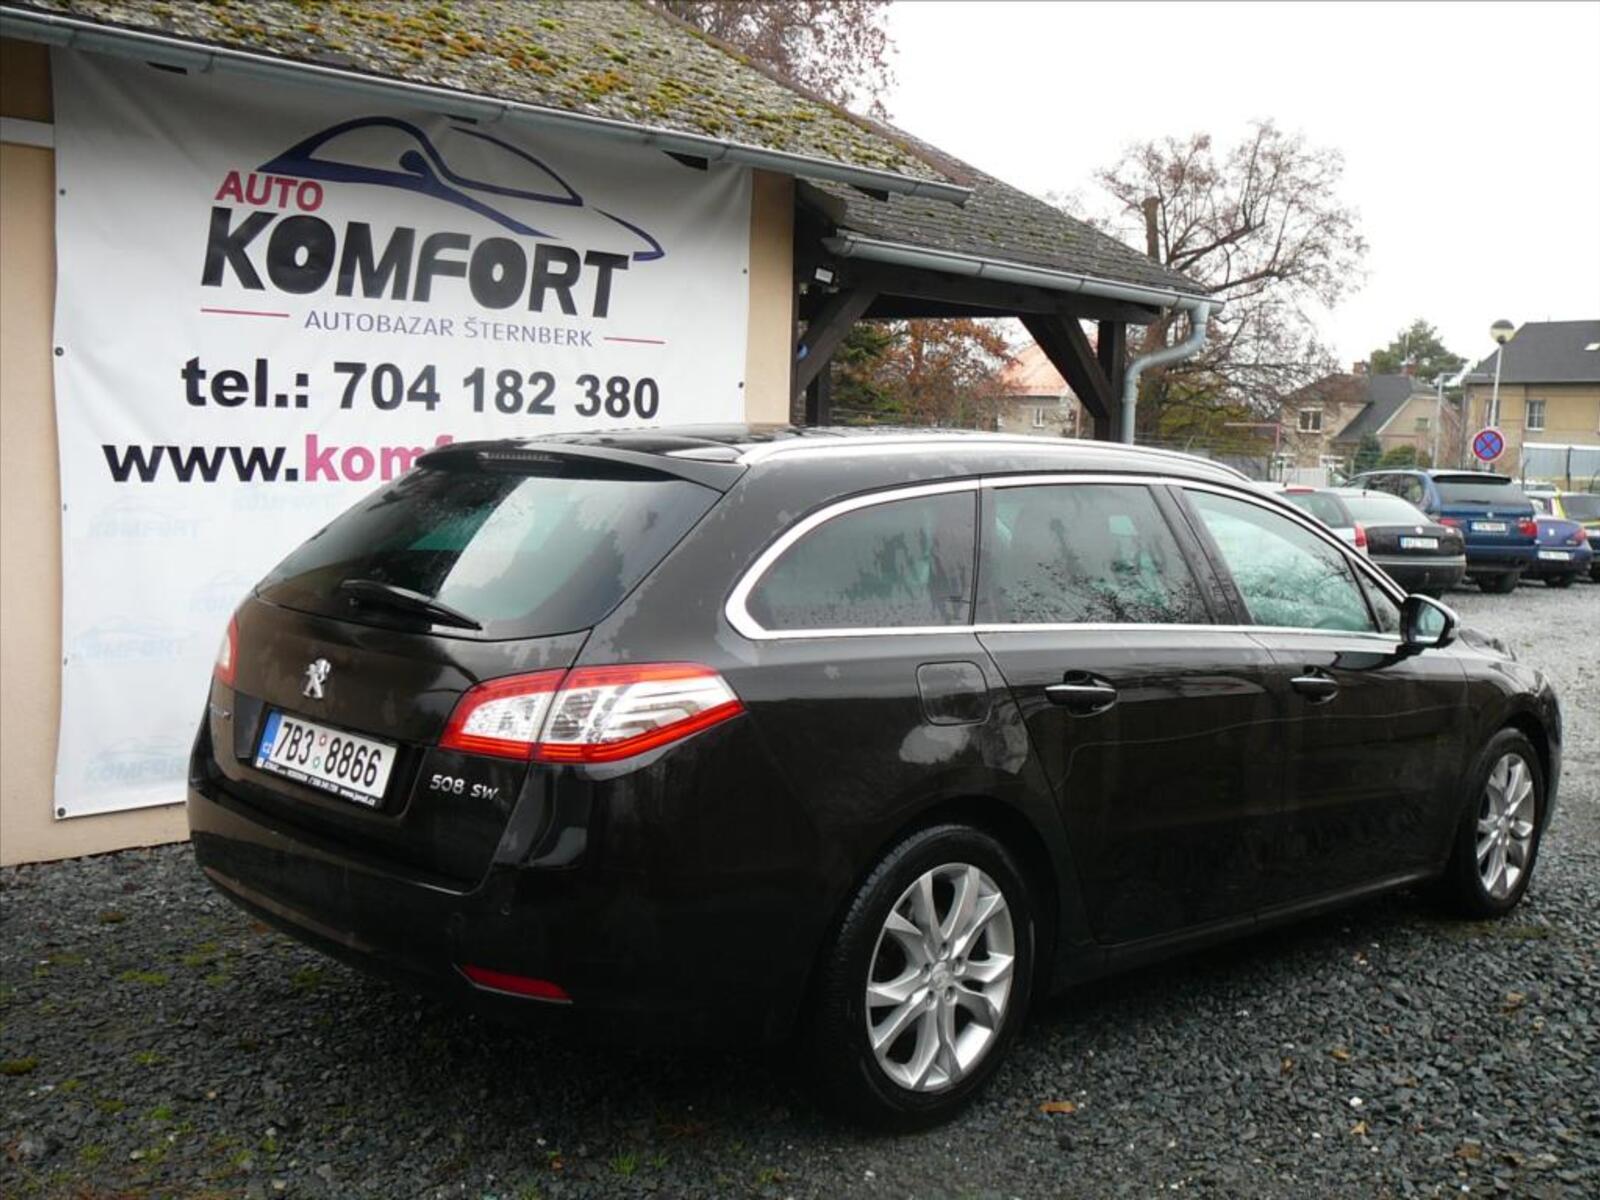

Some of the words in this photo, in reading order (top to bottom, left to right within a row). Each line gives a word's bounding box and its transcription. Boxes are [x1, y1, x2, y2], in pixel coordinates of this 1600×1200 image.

[215, 170, 323, 212] AUTO
[201, 206, 630, 319] KOMFORT
[304, 309, 454, 338] AUTOBAZAR
[464, 316, 594, 347] ŠTERNBERK
[181, 356, 309, 409] tel.:
[333, 361, 441, 411] 704
[463, 366, 556, 415] 182
[574, 373, 660, 419] 380
[274, 721, 315, 765] 7B3
[324, 737, 382, 787] 8866
[429, 774, 464, 794] 508
[470, 783, 499, 800] SW
